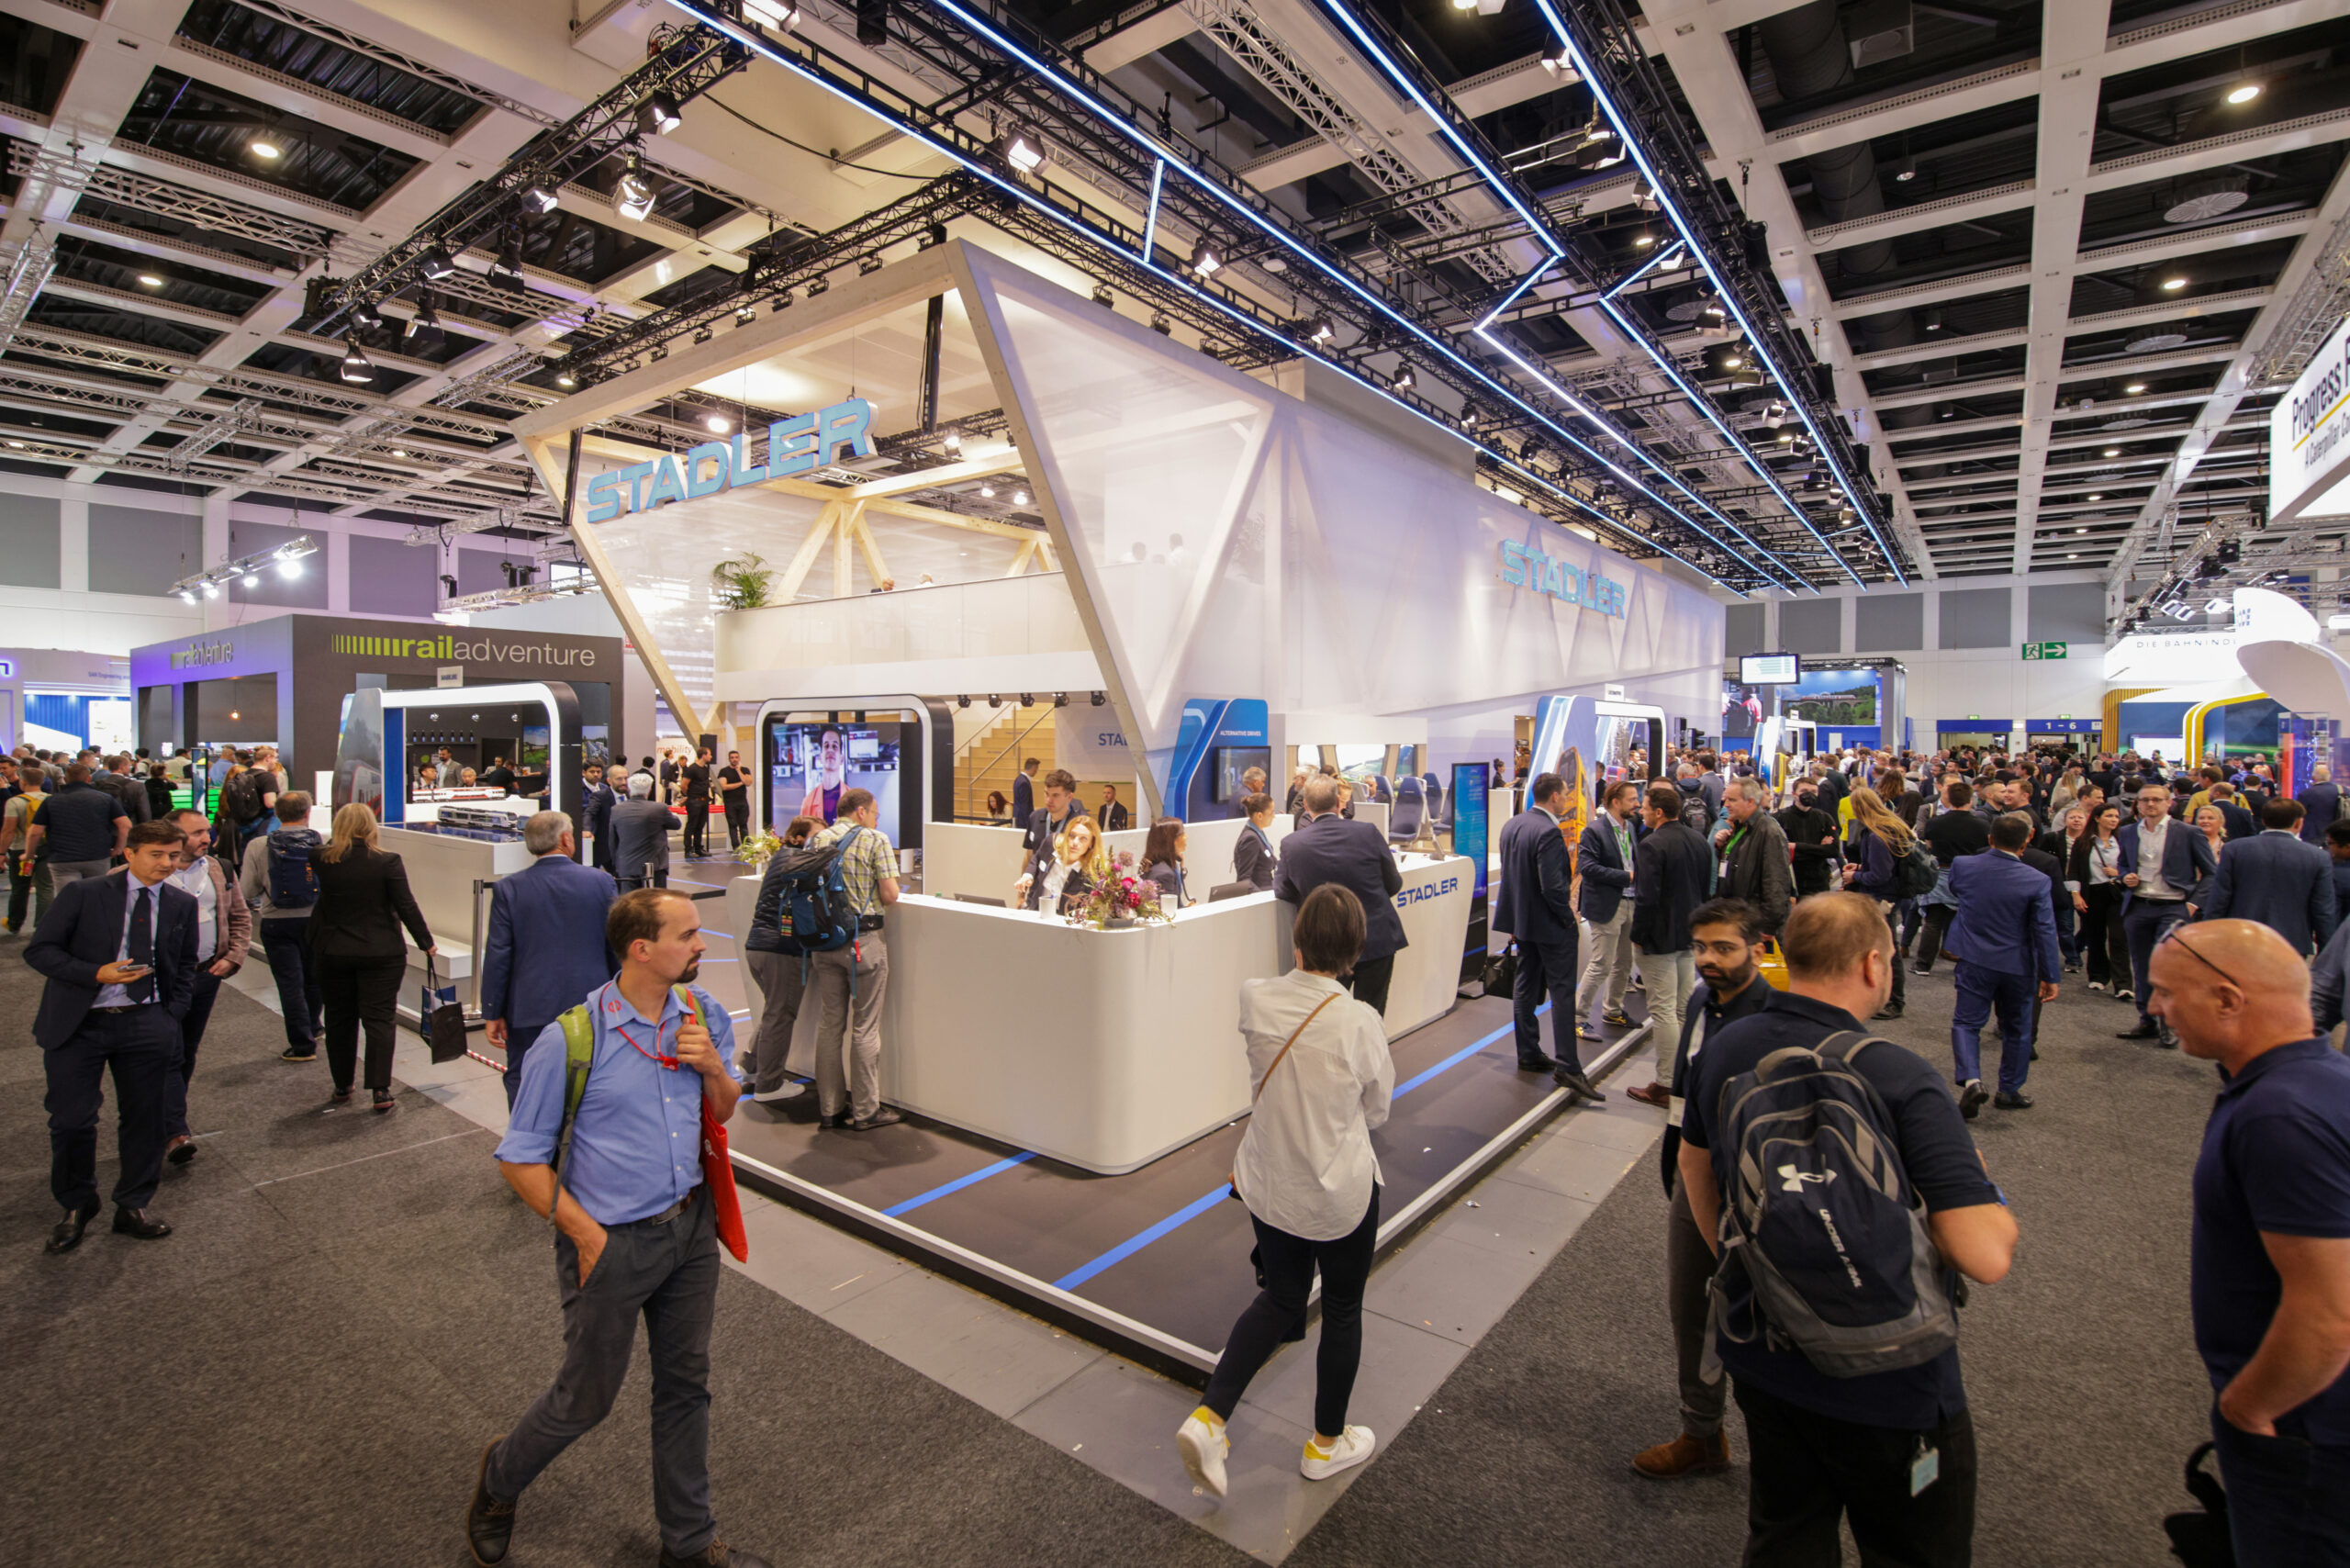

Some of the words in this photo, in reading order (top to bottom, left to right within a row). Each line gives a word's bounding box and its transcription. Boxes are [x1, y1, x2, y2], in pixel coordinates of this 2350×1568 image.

[2293, 362, 2342, 442] Progress
[588, 398, 872, 523] STADLER
[1504, 538, 1625, 620] STADLER
[401, 635, 596, 666] railadventure
[1098, 733, 1128, 746] STA
[2045, 722, 2052, 730] 1
[2069, 722, 2076, 730] 6
[1397, 877, 1458, 908] STADLER
[1818, 1208, 1845, 1253] UNDER
